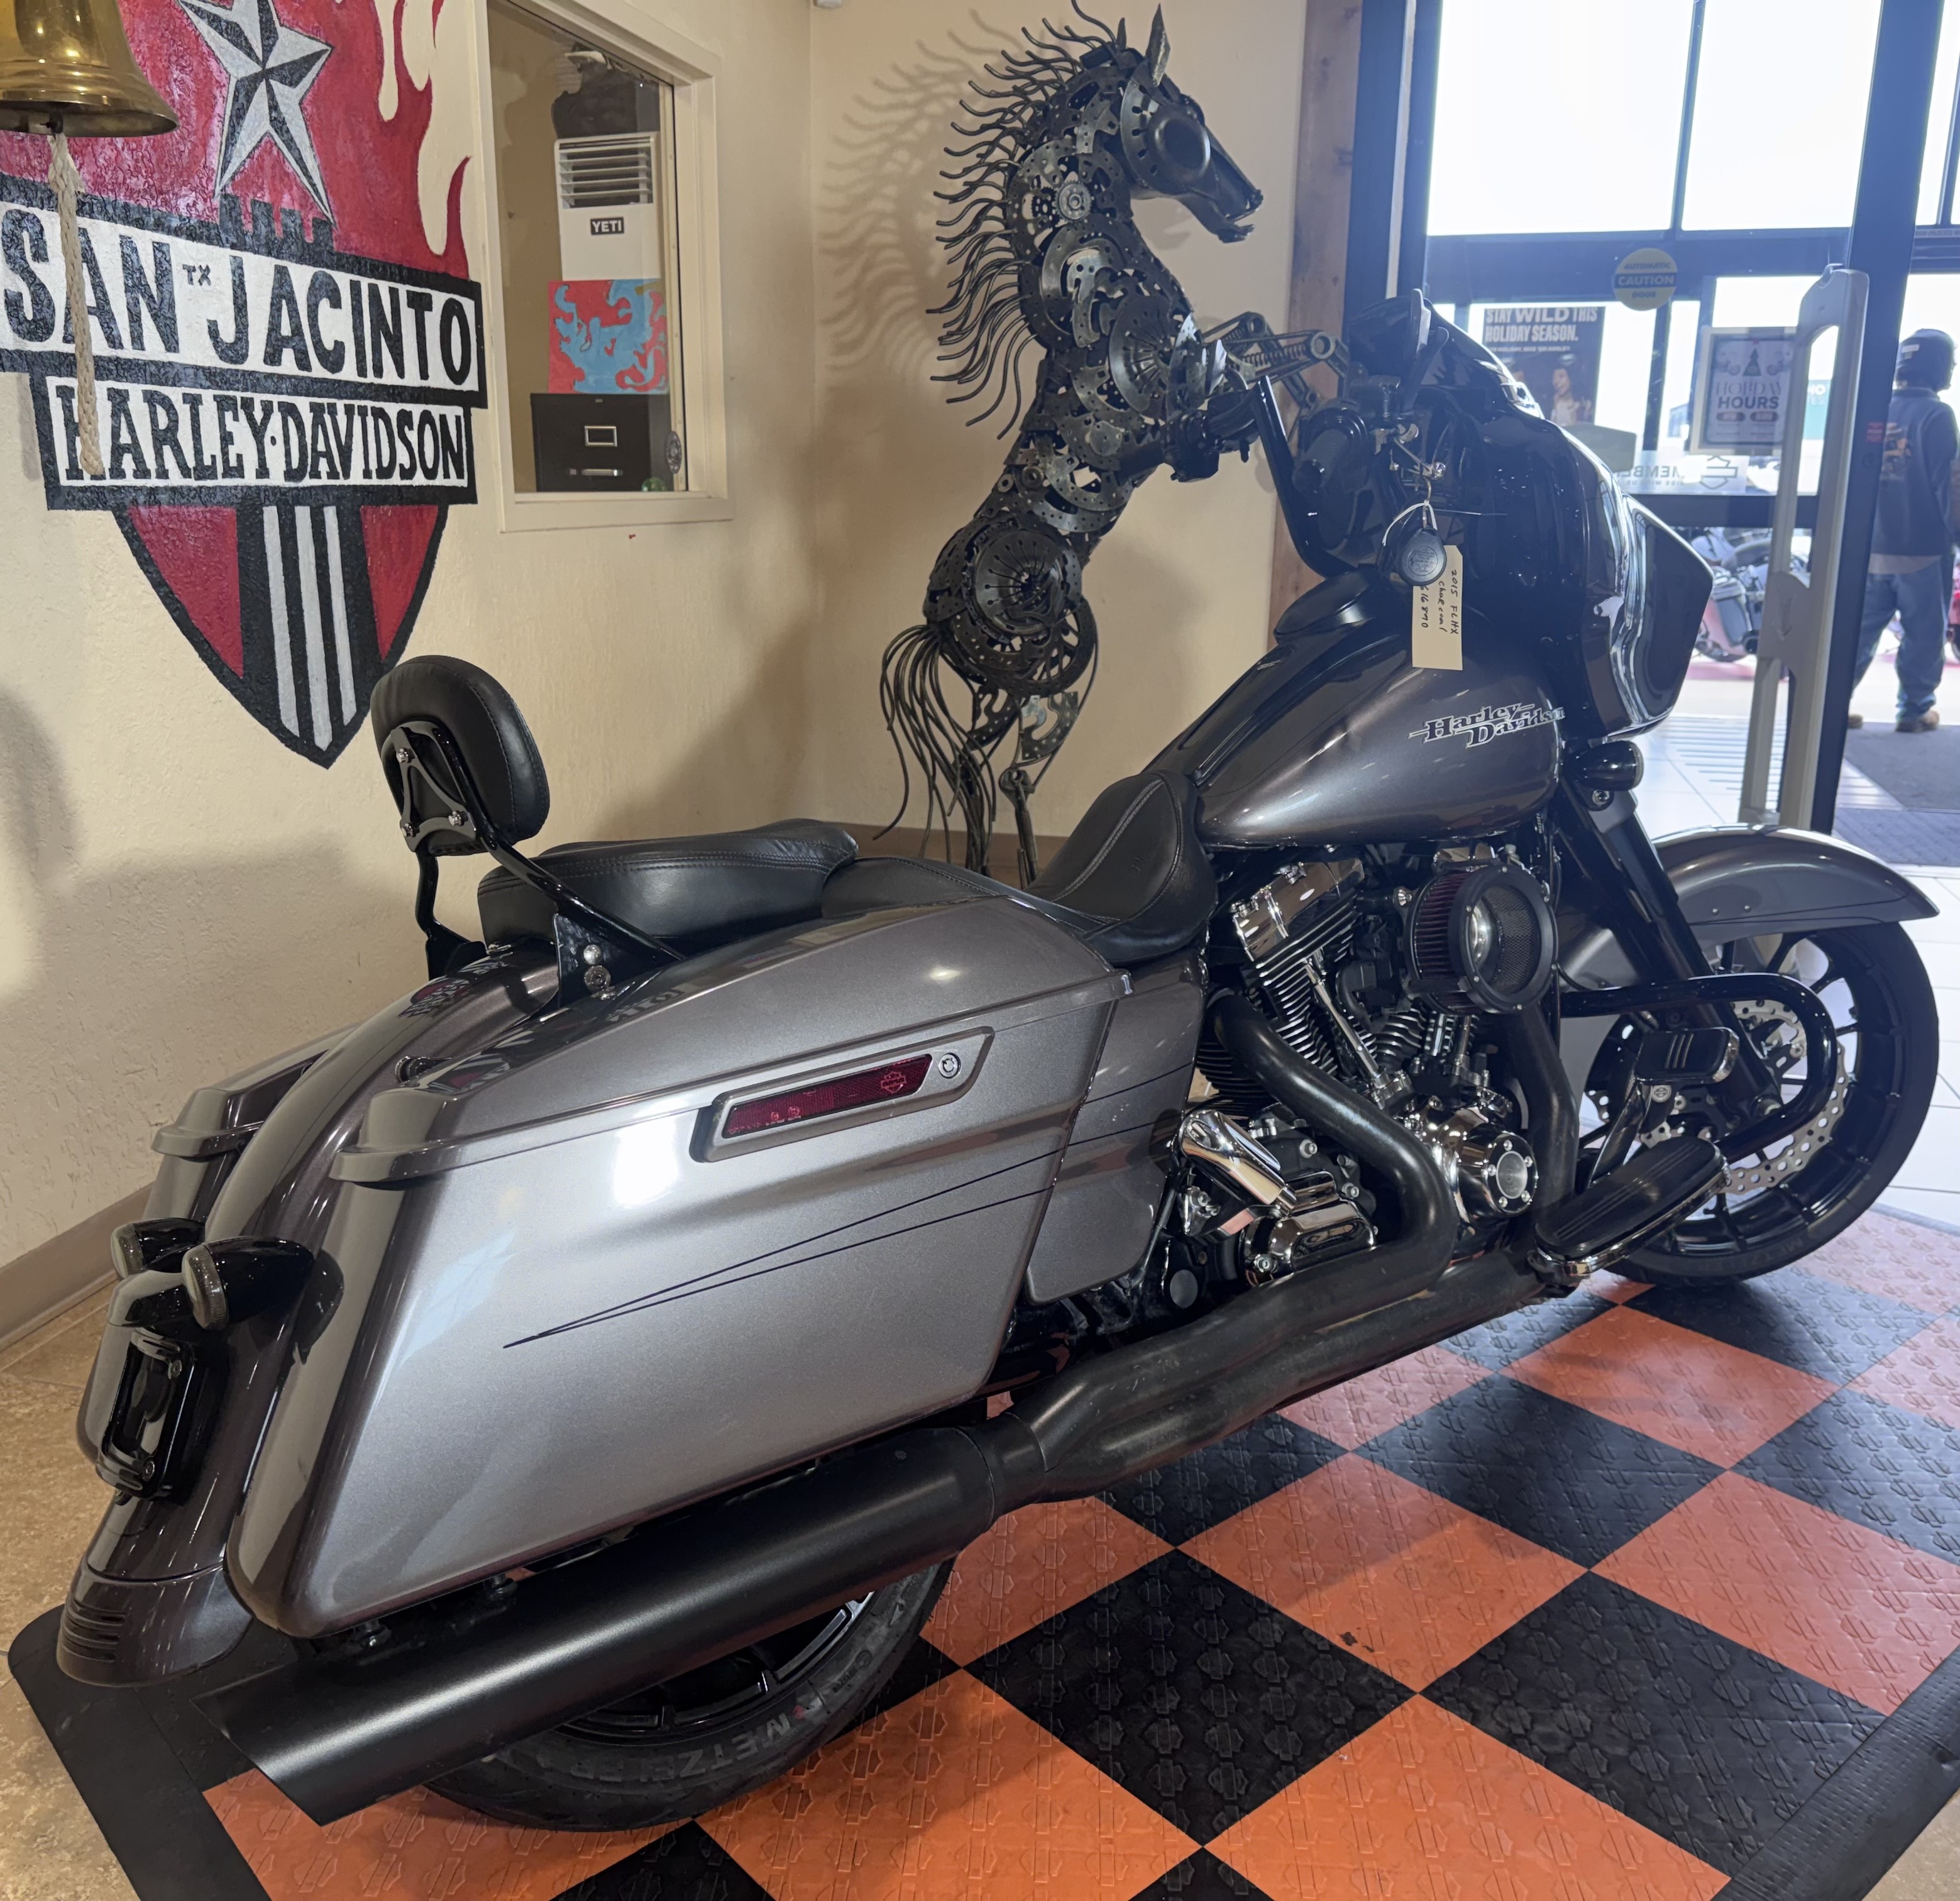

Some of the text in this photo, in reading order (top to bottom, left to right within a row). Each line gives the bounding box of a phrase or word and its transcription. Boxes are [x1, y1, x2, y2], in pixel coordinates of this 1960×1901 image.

[592, 220, 622, 233] YETI
[1619, 275, 1674, 286] CAUTION
[1, 209, 471, 386] SAN TX JACINTO
[1486, 307, 1598, 323] STAY WILD THIS
[1485, 324, 1579, 342] HOLIDAY SEASON.
[1717, 397, 1780, 409] HOURS
[1450, 605, 1460, 635] FLHX
[1423, 703, 1522, 743] Harley
[1465, 707, 1565, 749] Davidson
